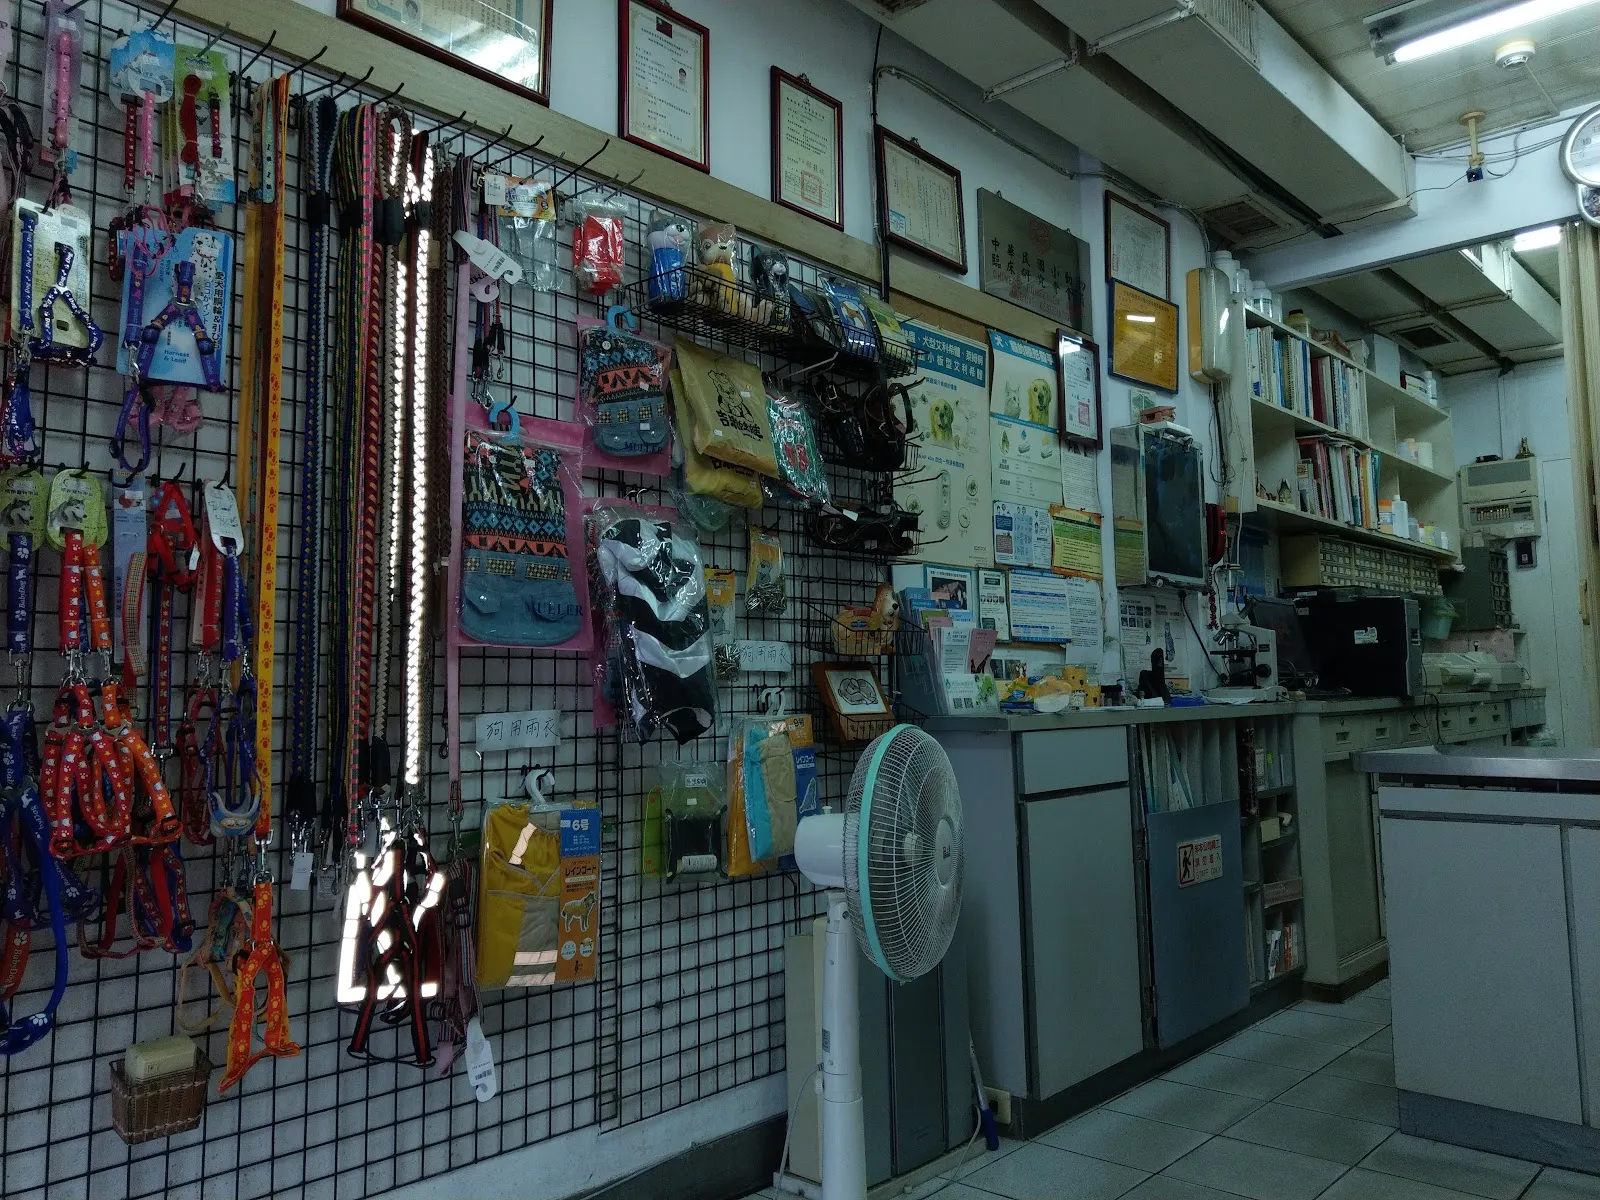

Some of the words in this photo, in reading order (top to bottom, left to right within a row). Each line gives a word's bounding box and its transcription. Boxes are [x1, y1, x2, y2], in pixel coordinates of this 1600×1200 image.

[164, 349, 190, 358] Harness
[171, 355, 187, 364] Lead
[625, 441, 663, 455] MULLER
[19, 579, 27, 609] BabyDog
[525, 596, 584, 617] MULLER
[486, 717, 560, 741] 狗用雨衣
[571, 818, 590, 831] 6号
